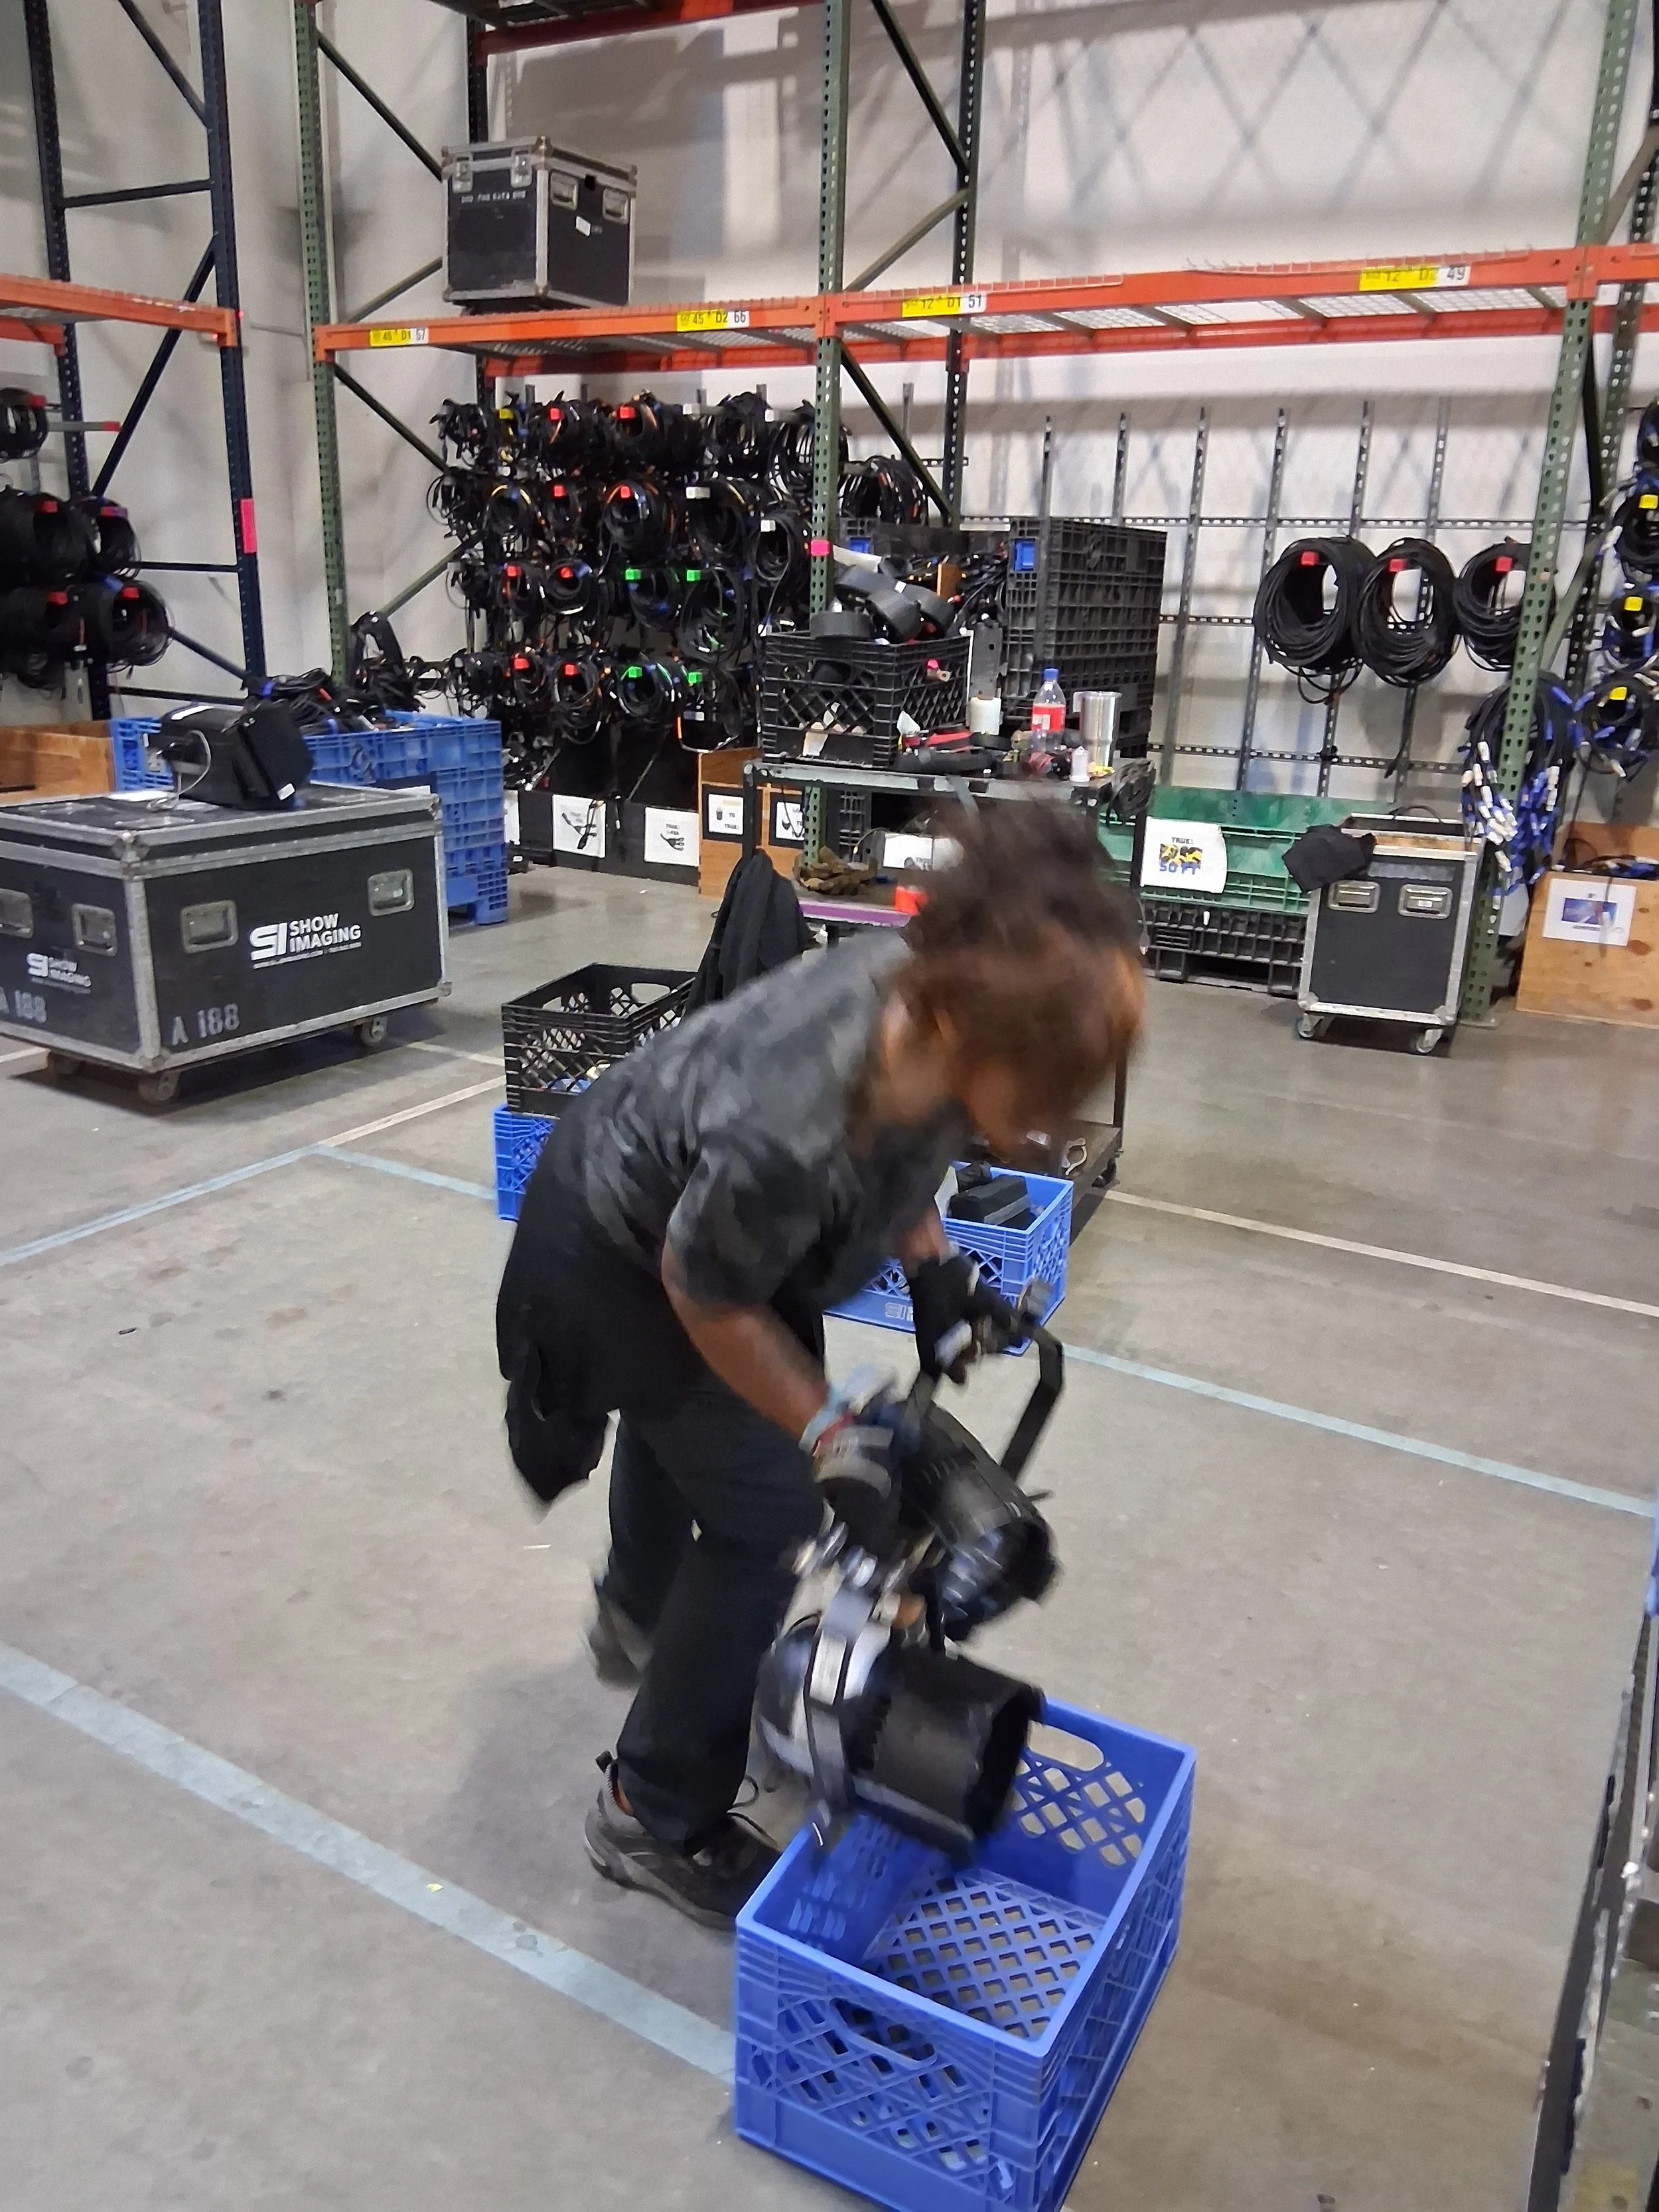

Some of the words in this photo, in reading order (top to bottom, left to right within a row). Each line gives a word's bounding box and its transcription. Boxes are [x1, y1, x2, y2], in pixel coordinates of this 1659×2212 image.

[968, 294, 982, 308] 51
[693, 311, 704, 324] 45
[716, 311, 729, 323] D2
[289, 913, 339, 936] SHOW
[289, 924, 362, 953] IMAGING
[171, 1016, 189, 1046] A
[197, 1003, 241, 1039] 188
